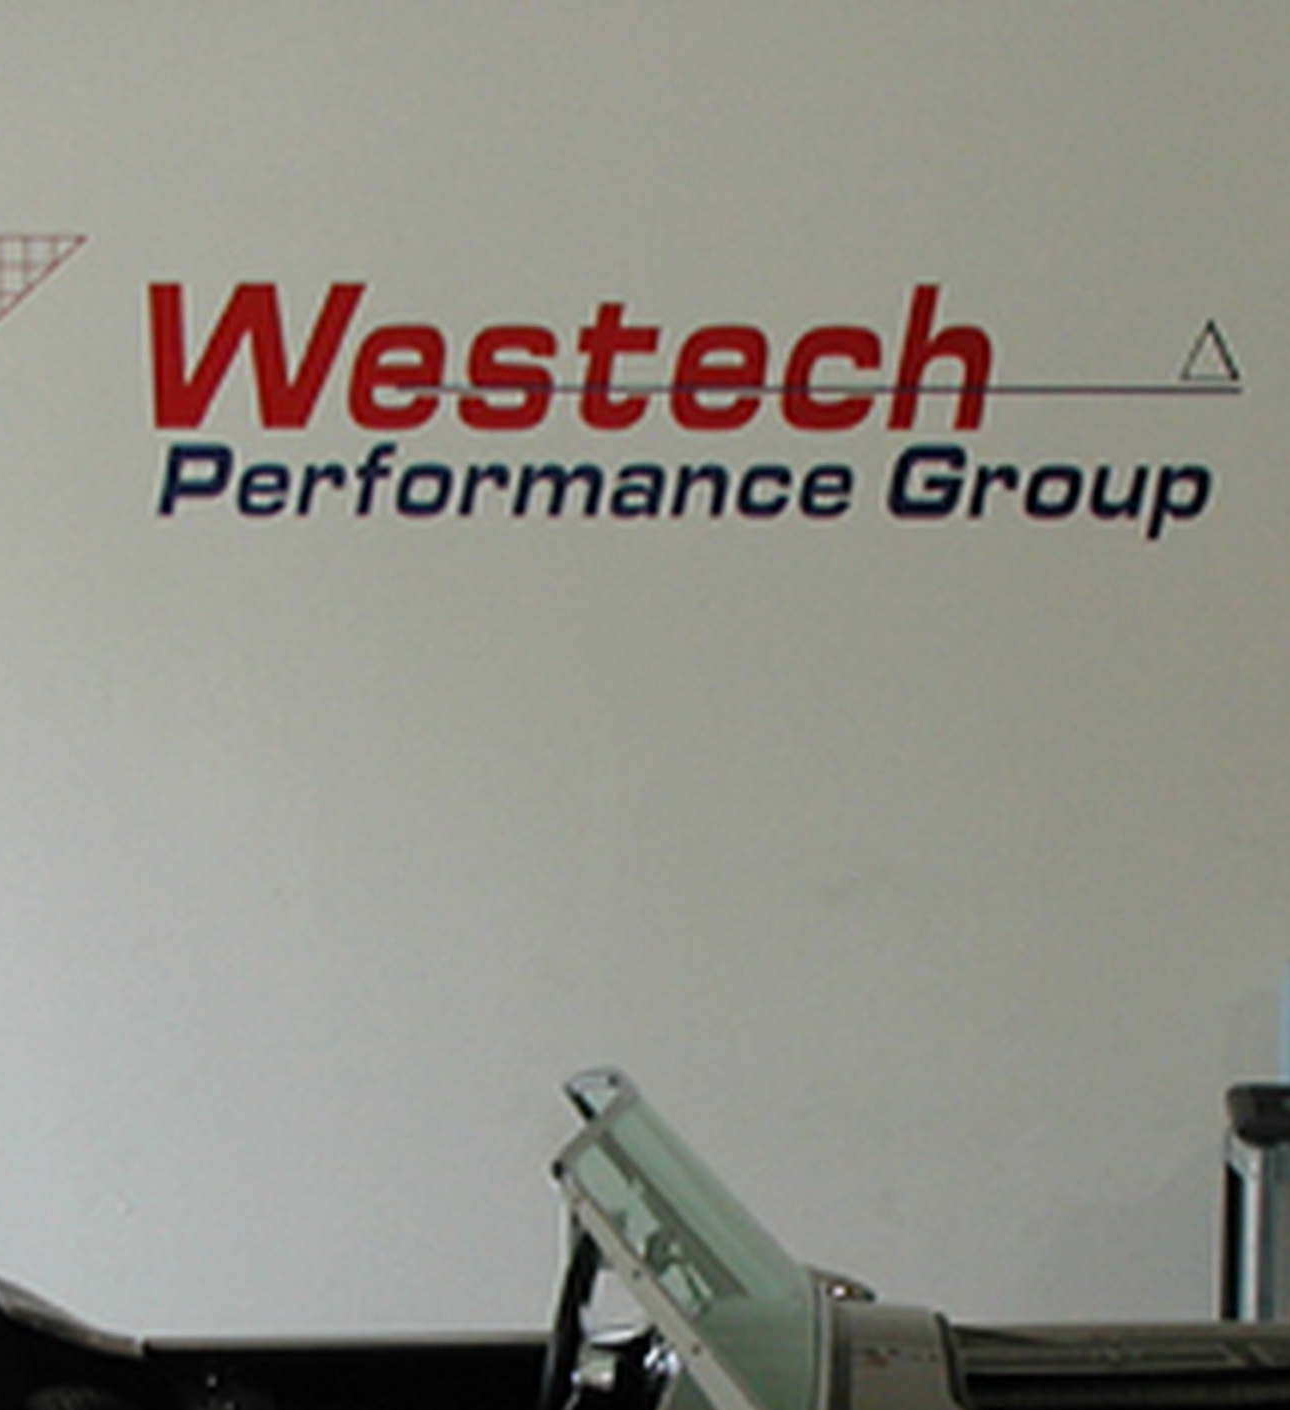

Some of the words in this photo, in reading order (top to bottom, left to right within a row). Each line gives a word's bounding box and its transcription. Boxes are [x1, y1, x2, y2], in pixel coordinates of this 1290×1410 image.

[147, 282, 993, 432] Westech
[157, 442, 855, 520] Performance
[886, 444, 1213, 542] Group
